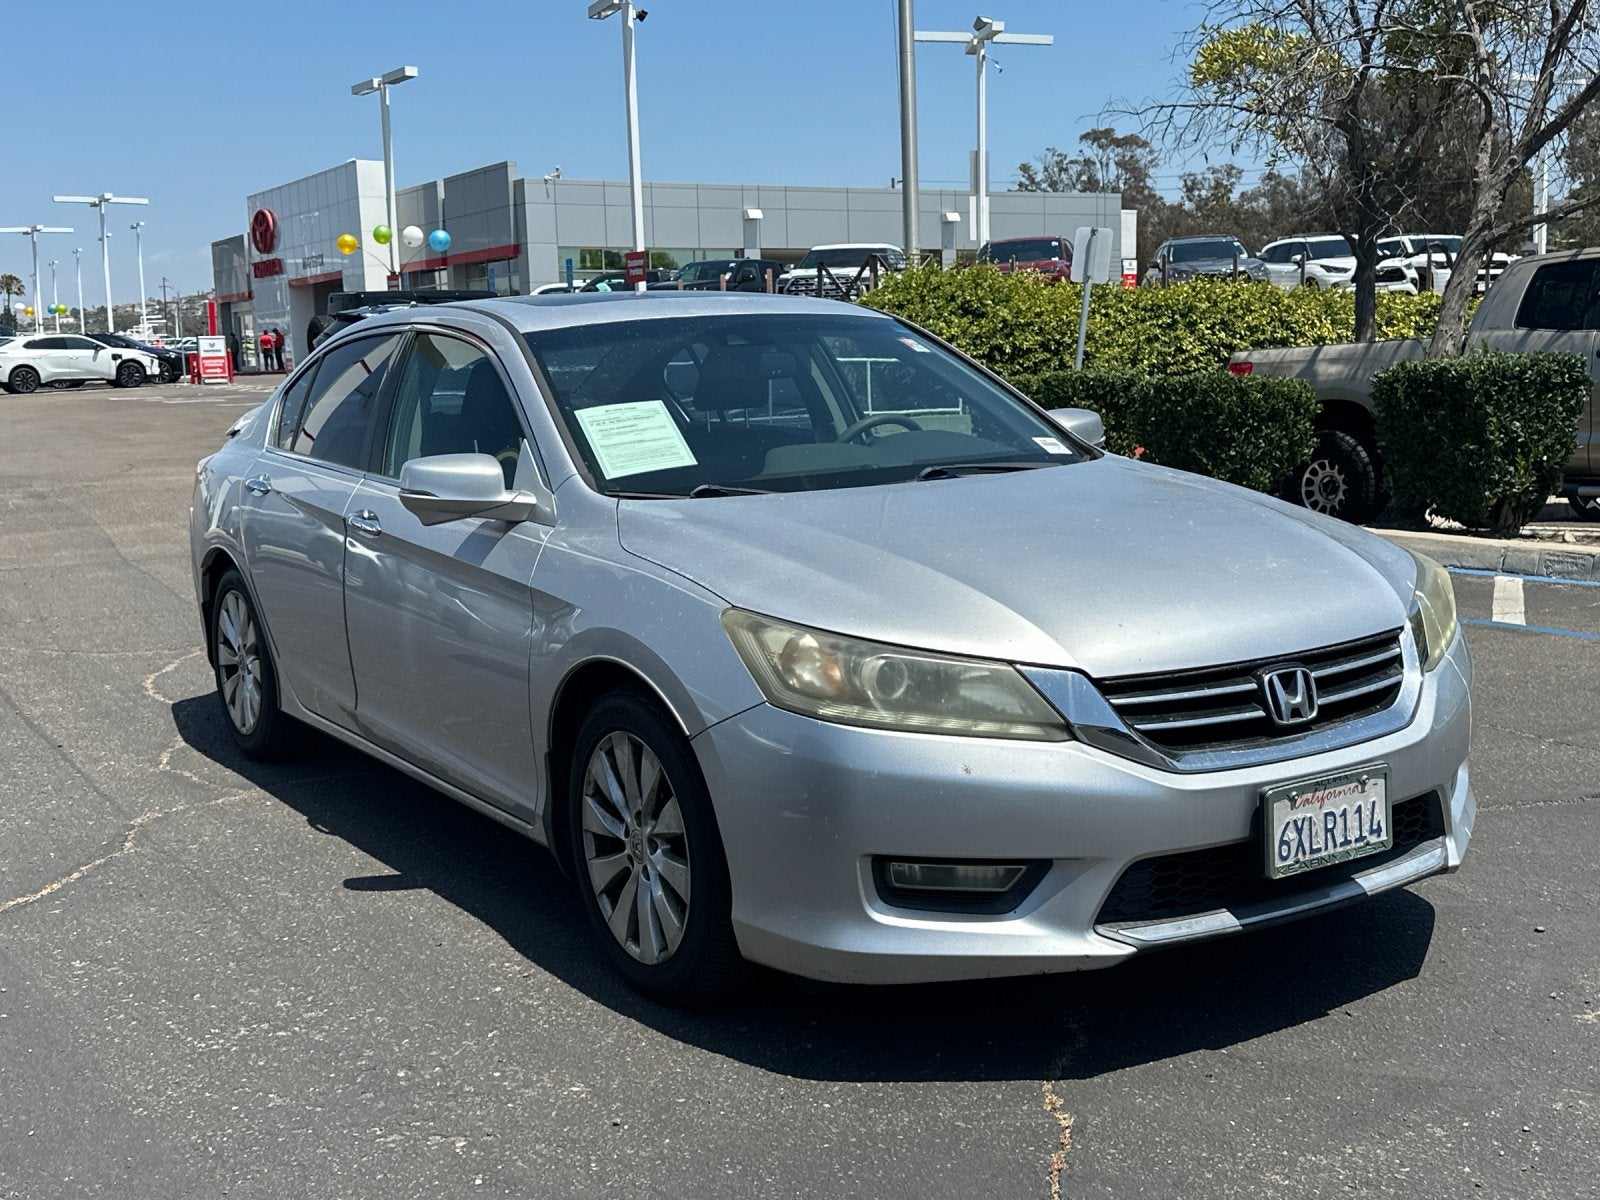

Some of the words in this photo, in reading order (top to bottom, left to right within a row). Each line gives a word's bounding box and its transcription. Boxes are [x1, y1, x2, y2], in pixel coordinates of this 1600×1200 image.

[1294, 782, 1360, 809] California
[1278, 799, 1383, 861] 6XLR114
[1345, 841, 1388, 861] MESA
